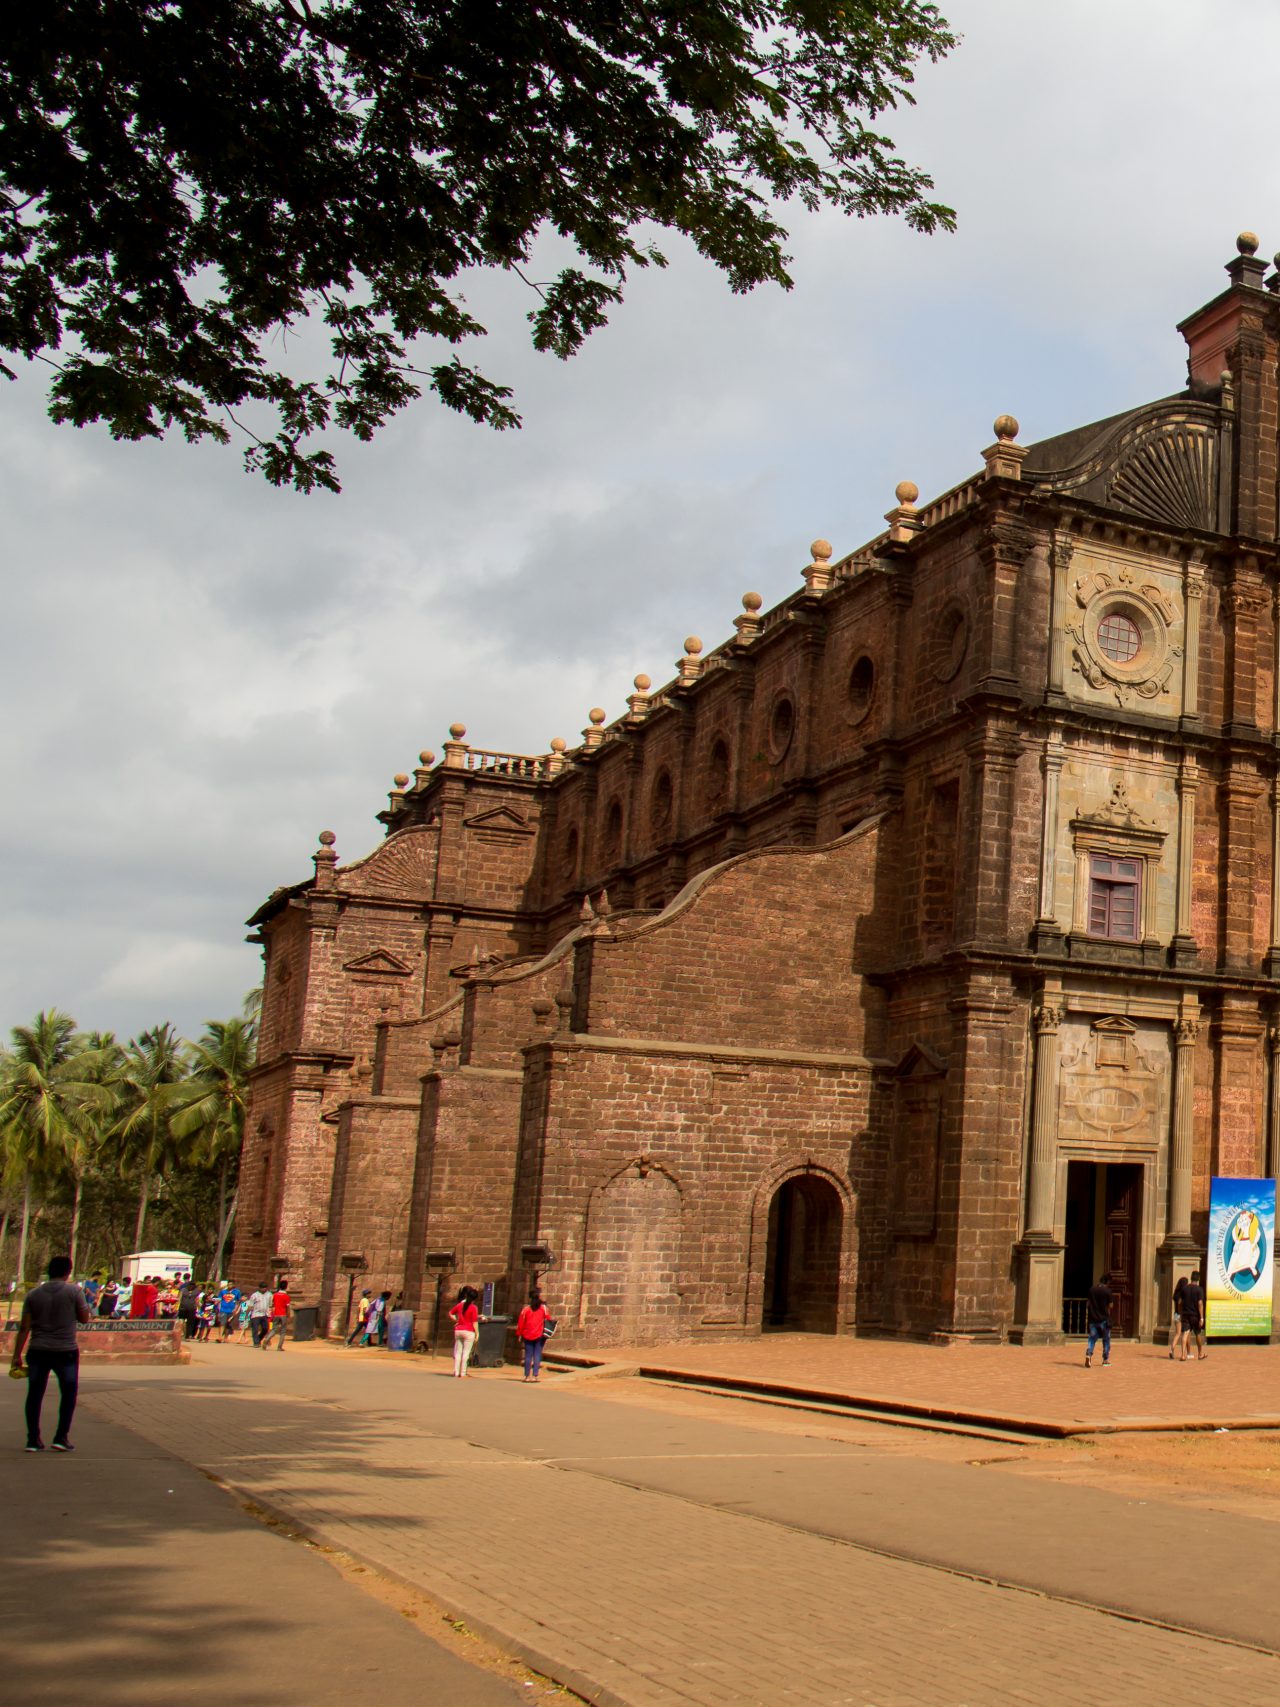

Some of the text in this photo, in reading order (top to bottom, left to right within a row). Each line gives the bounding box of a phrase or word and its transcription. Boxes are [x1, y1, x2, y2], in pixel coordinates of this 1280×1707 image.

[1217, 1228, 1226, 1243] THE
[1218, 1266, 1242, 1301] MERCIFUL
[77, 1322, 110, 1330] RITAGE
[112, 1322, 171, 1330] MONUMENT
